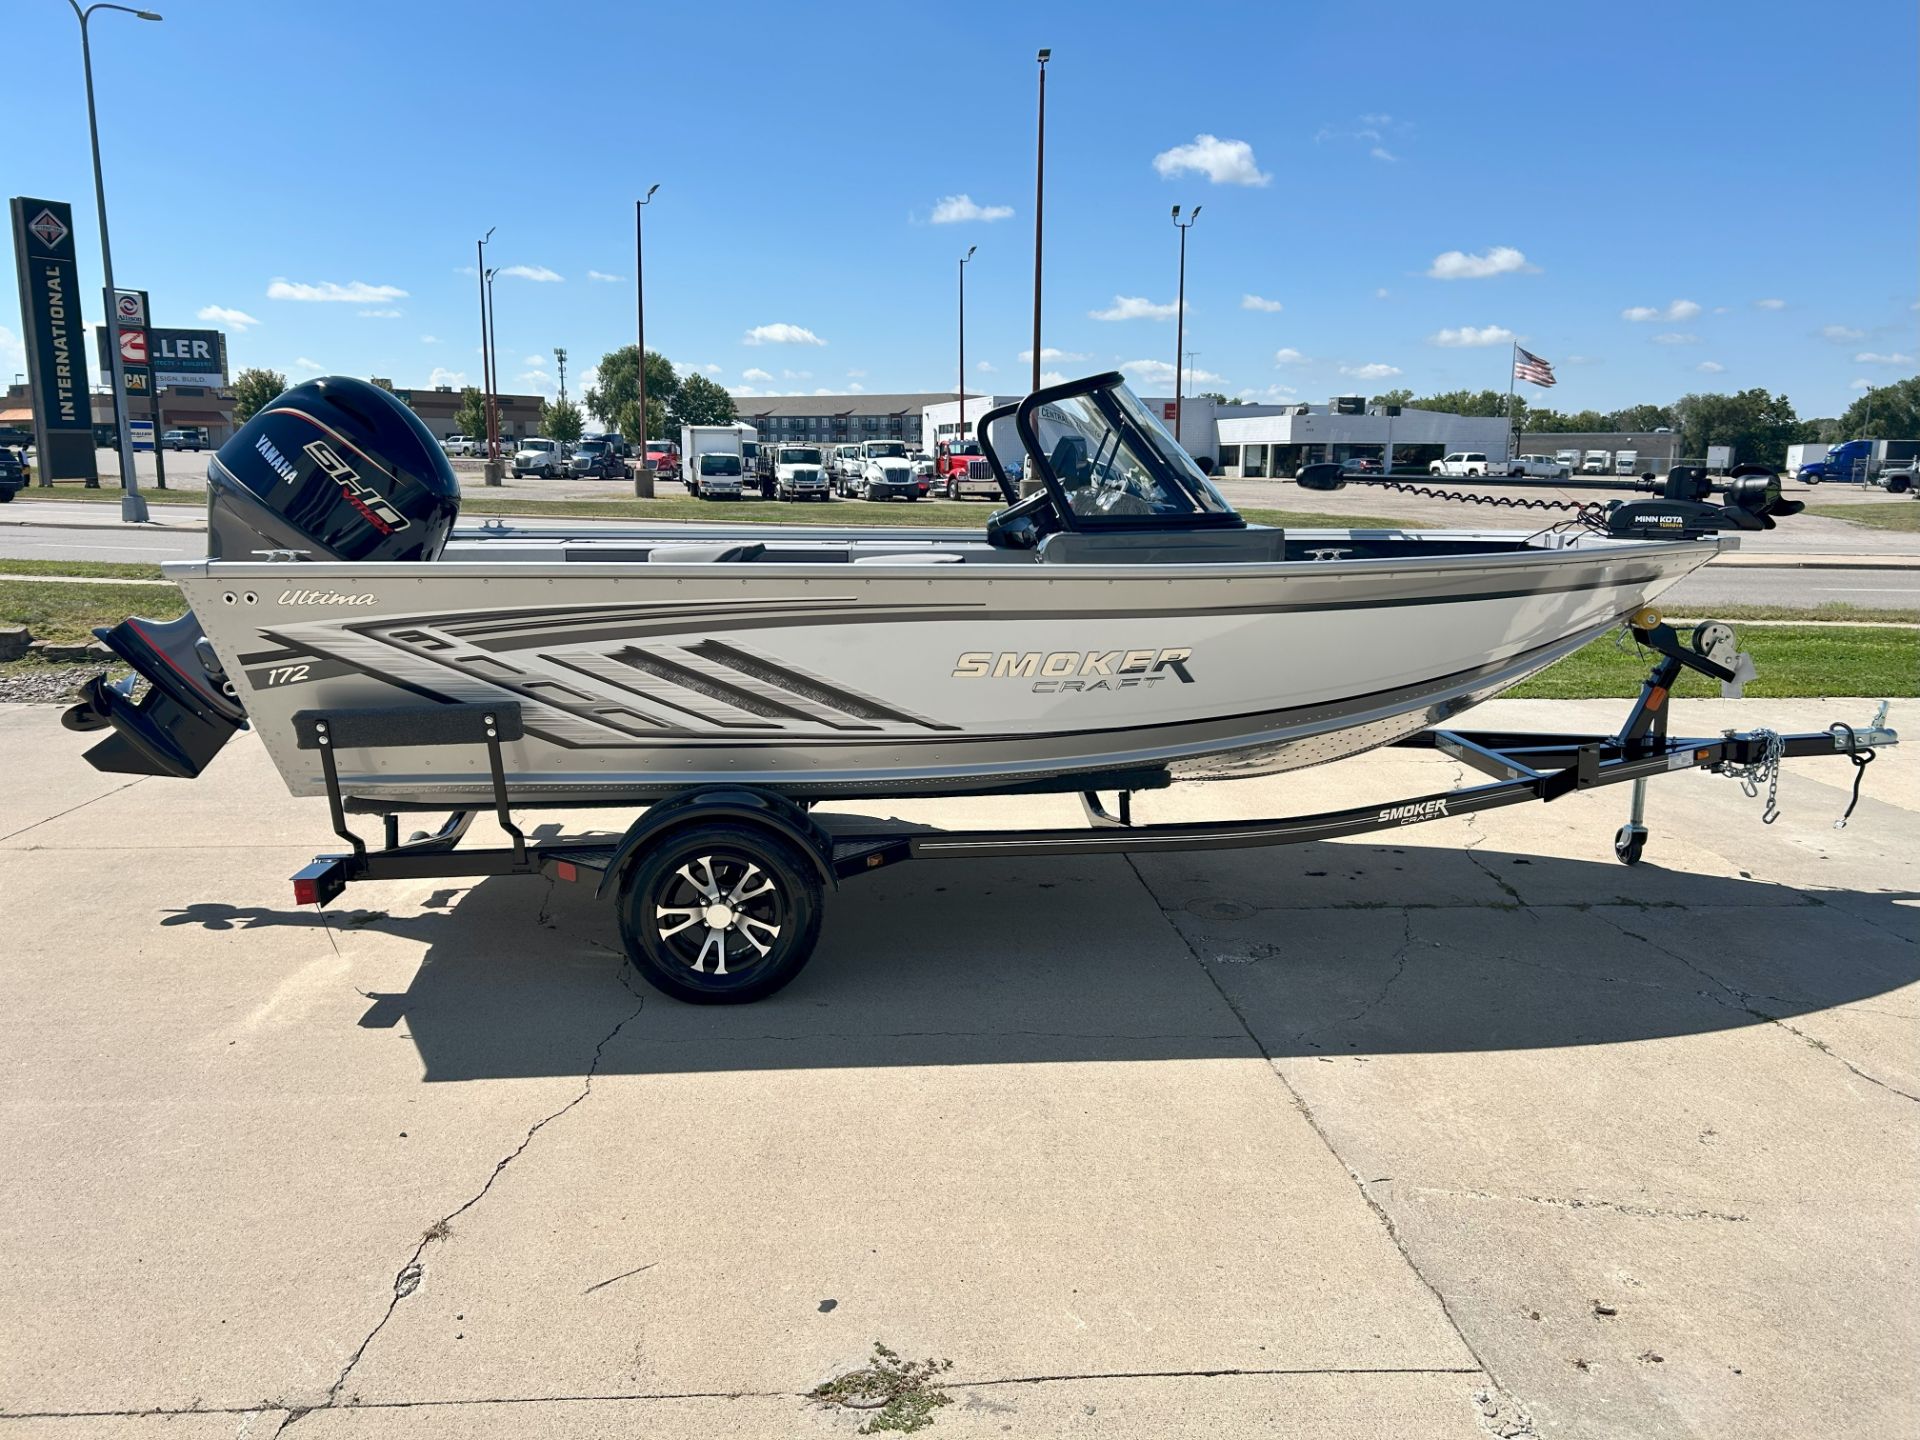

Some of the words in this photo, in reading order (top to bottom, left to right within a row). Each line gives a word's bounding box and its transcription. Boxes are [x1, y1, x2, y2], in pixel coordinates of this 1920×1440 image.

[46, 266, 76, 421] INTERNATIONAL
[124, 373, 147, 390] CAT
[255, 433, 298, 485] YAMAHA
[303, 440, 411, 532] SHO
[1634, 515, 1659, 523] MINN
[1660, 515, 1683, 523] KOTA
[277, 590, 379, 606] Ultima
[268, 665, 310, 685] 172
[951, 647, 1195, 683] SMOKER
[1032, 676, 1165, 693] CRAFT
[1377, 799, 1449, 822] SMOKER
[1400, 812, 1440, 825] CRAFT
